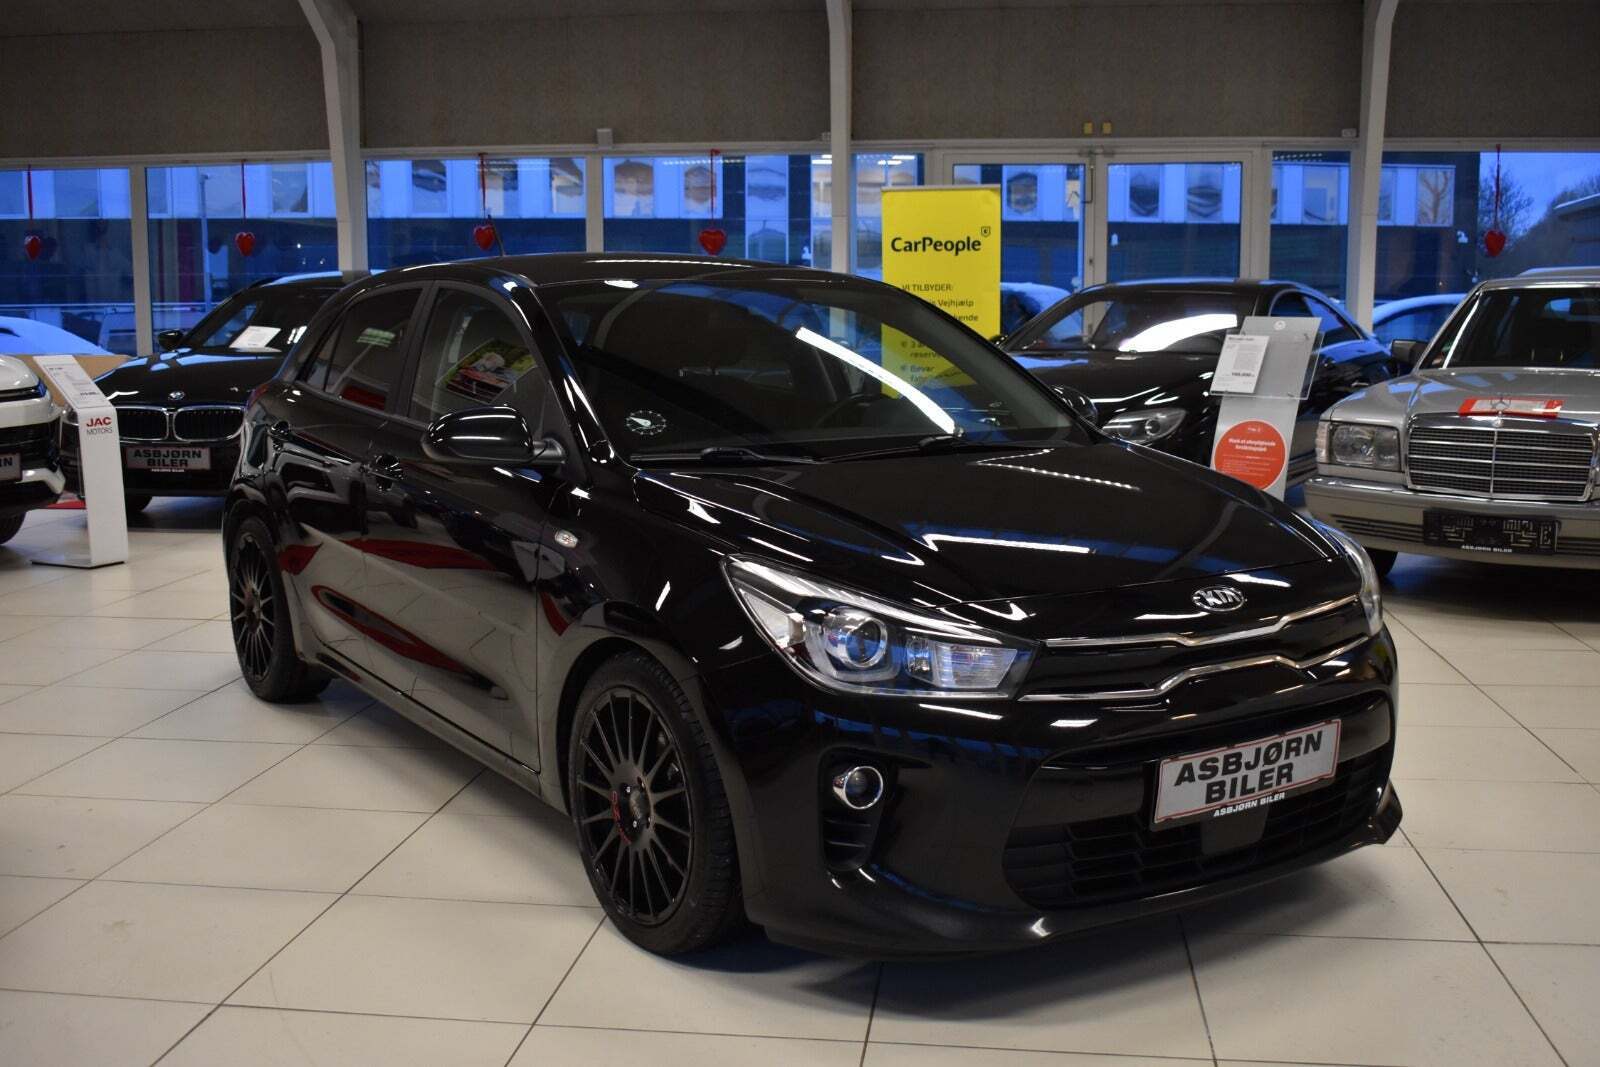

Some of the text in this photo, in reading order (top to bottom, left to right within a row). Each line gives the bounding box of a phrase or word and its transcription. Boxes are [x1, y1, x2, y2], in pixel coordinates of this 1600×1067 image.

[890, 236, 982, 256] CarPeople
[938, 299, 974, 309] Vejhjælp
[86, 416, 112, 427] JAC
[86, 426, 113, 436] MOTORS
[134, 449, 202, 458] ASBJØRN
[147, 458, 188, 467] BILER
[1197, 587, 1242, 607] KIA
[1174, 730, 1323, 786] ASBJØRN
[1204, 762, 1294, 804] BILER
[1260, 791, 1286, 805] BILER
